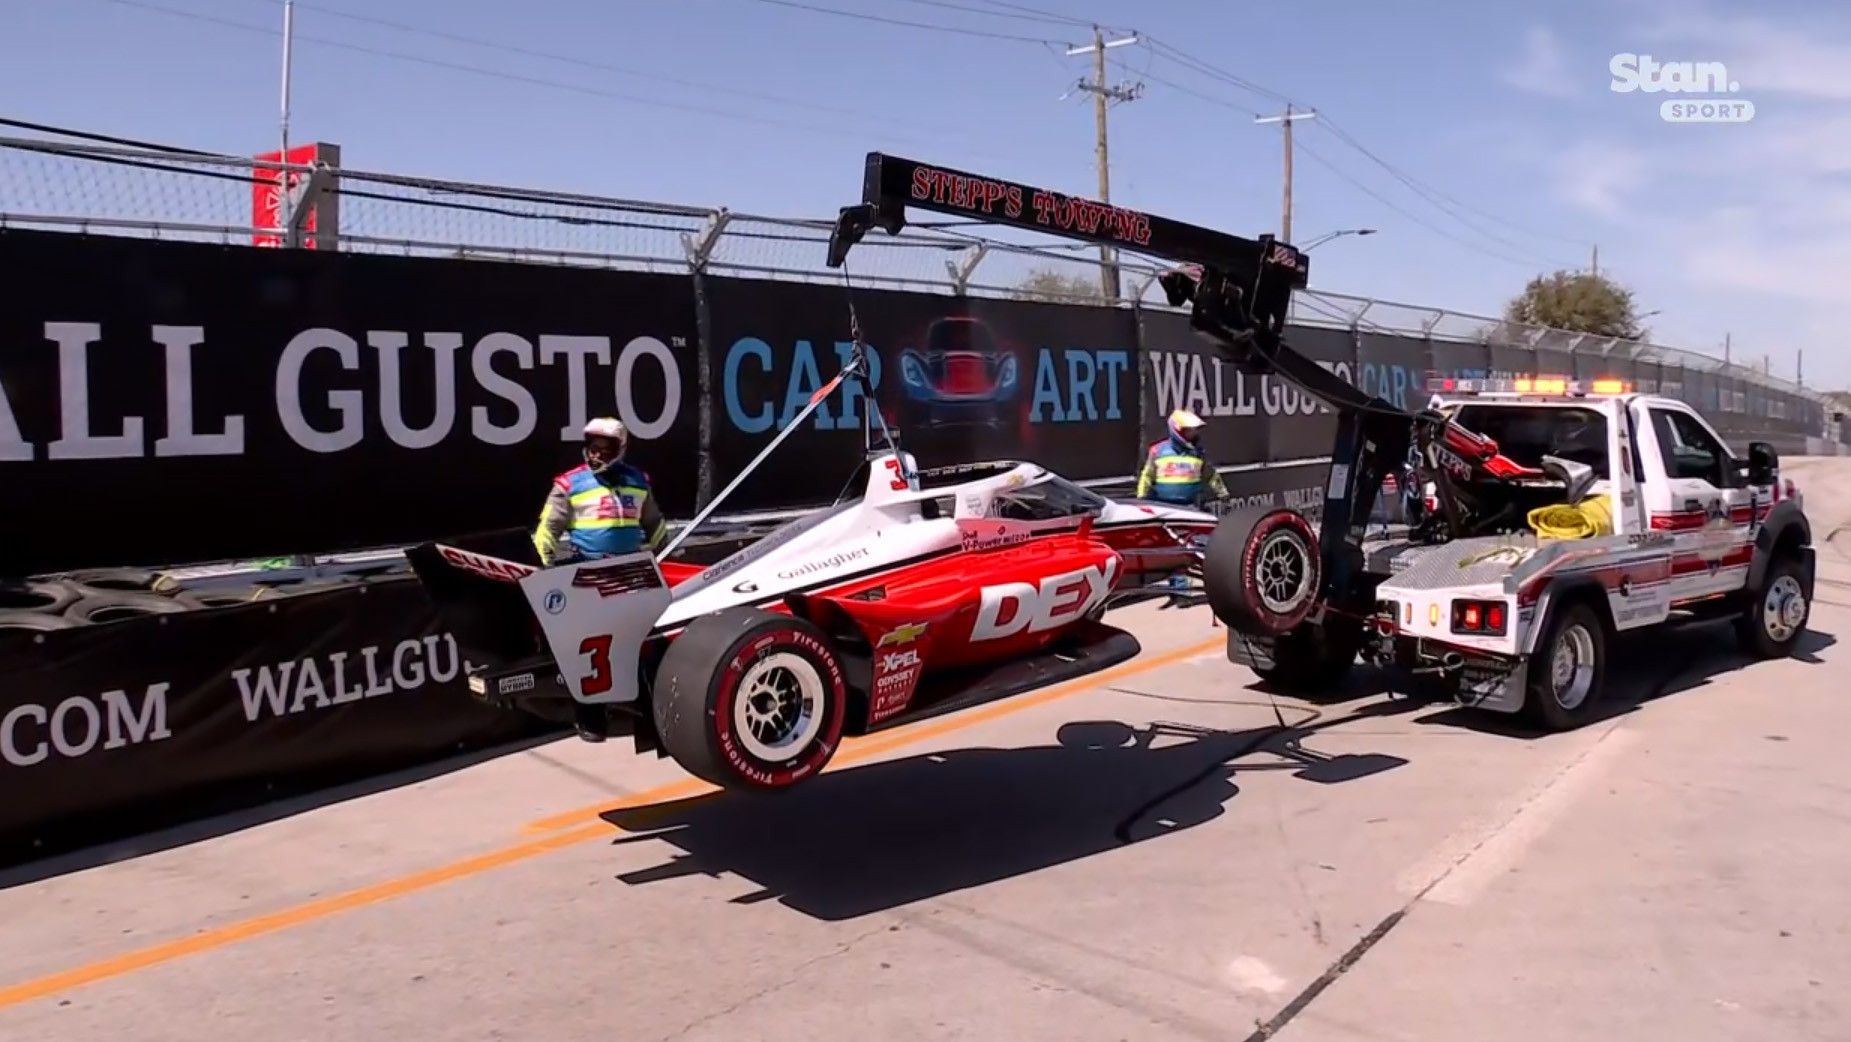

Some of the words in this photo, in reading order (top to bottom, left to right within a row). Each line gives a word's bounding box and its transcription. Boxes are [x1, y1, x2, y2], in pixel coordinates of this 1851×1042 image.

[911, 167, 1023, 218] STEPP'S
[1033, 191, 1152, 246] TOWING
[275, 327, 681, 452] GUSTO
[723, 337, 882, 434] CAR
[1029, 348, 1128, 423] ART
[1150, 351, 1256, 417] WALL
[1362, 363, 1408, 411] CAR
[885, 459, 908, 491] 3
[732, 580, 759, 594] G
[777, 547, 869, 580] Gallagher
[962, 537, 1002, 551] V-Power
[969, 556, 1117, 643] DEX
[231, 632, 467, 722] WALLGU
[578, 634, 613, 696] 3
[792, 631, 842, 685] Firestone
[0, 681, 172, 767] COM
[721, 731, 774, 784] Firestone
